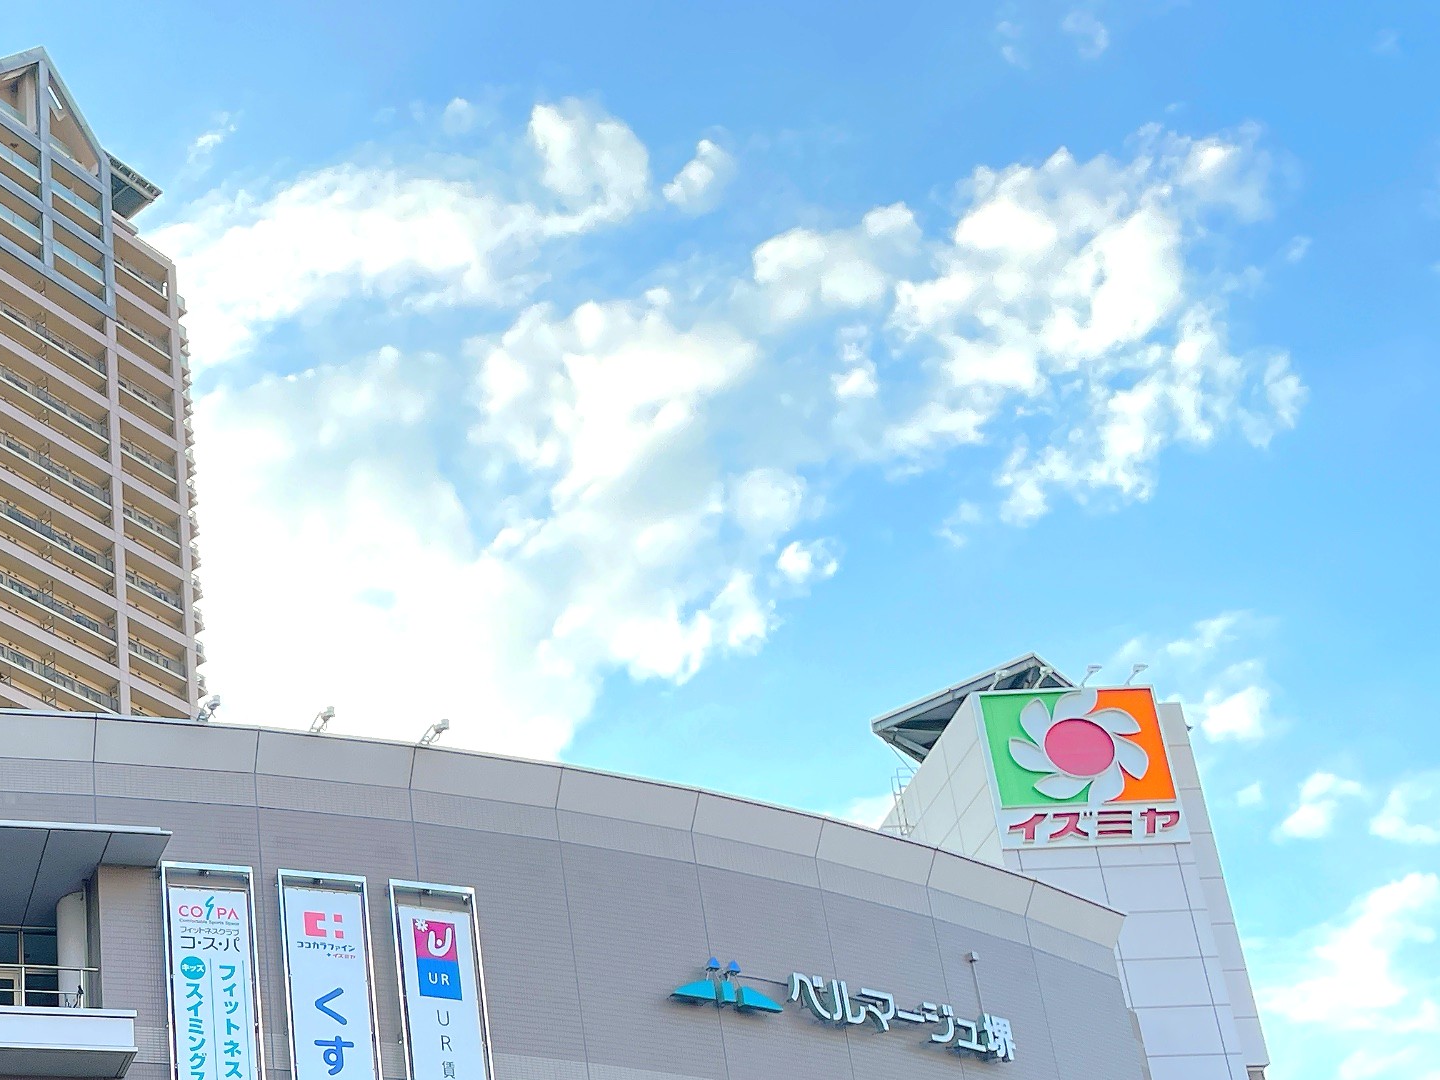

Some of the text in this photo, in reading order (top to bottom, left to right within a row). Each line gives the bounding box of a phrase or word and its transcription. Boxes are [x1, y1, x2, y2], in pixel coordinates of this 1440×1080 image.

[1007, 808, 1181, 844] イズミヤ
[180, 926, 240, 936] フィットネスクラブ
[297, 941, 355, 952] ココカラファイン
[428, 972, 450, 986] UR
[788, 972, 1016, 1061] ベルマージュ堺
